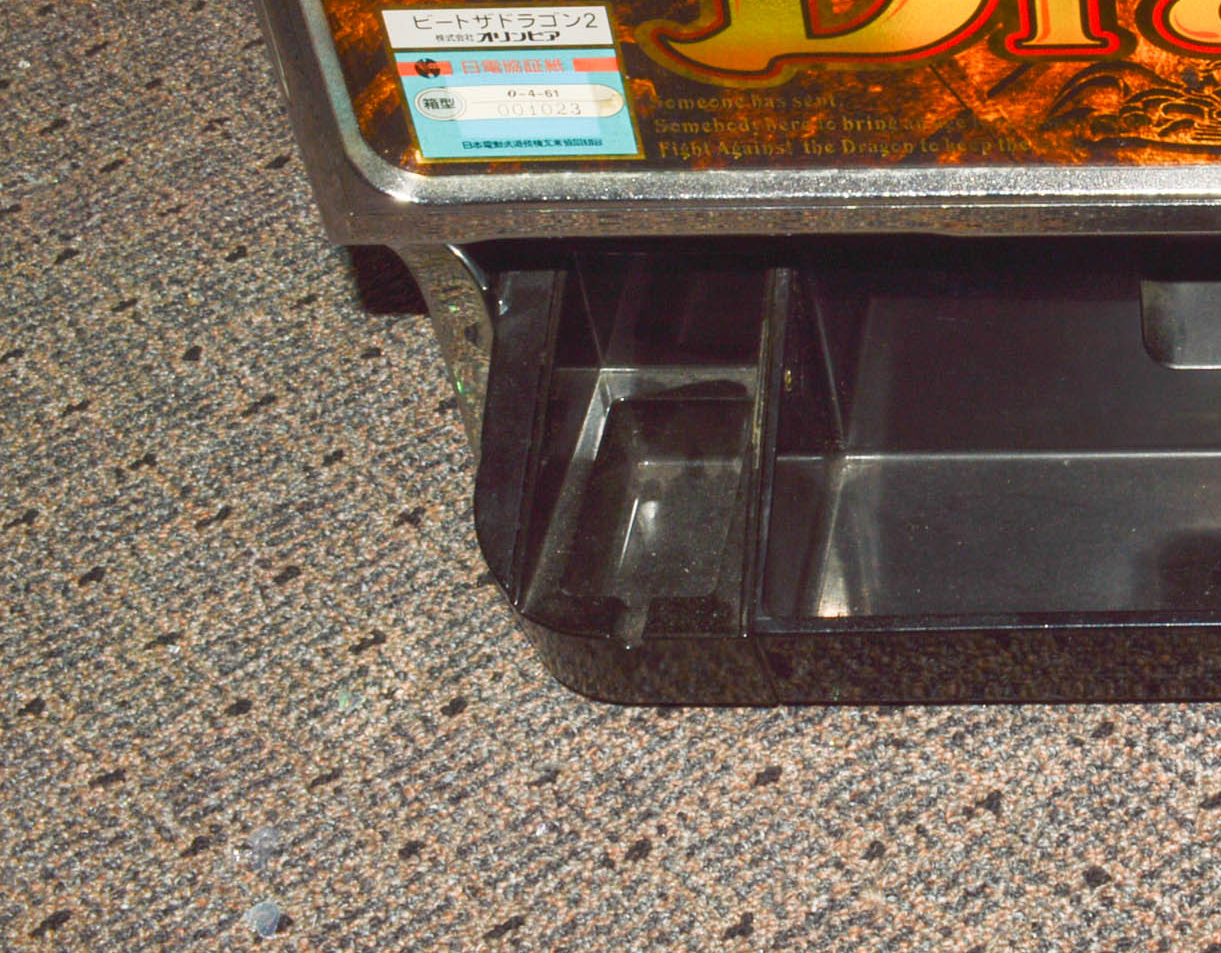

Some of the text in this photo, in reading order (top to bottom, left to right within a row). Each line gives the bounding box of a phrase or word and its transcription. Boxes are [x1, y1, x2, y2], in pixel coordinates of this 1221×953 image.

[413, 13, 599, 31] ビートザドラゴン2
[436, 31, 561, 43] 株式会社 オリンピア
[497, 102, 582, 115] 001023
[658, 140, 712, 160] Fight
[803, 139, 835, 155] the
[841, 138, 914, 158] Dragon
